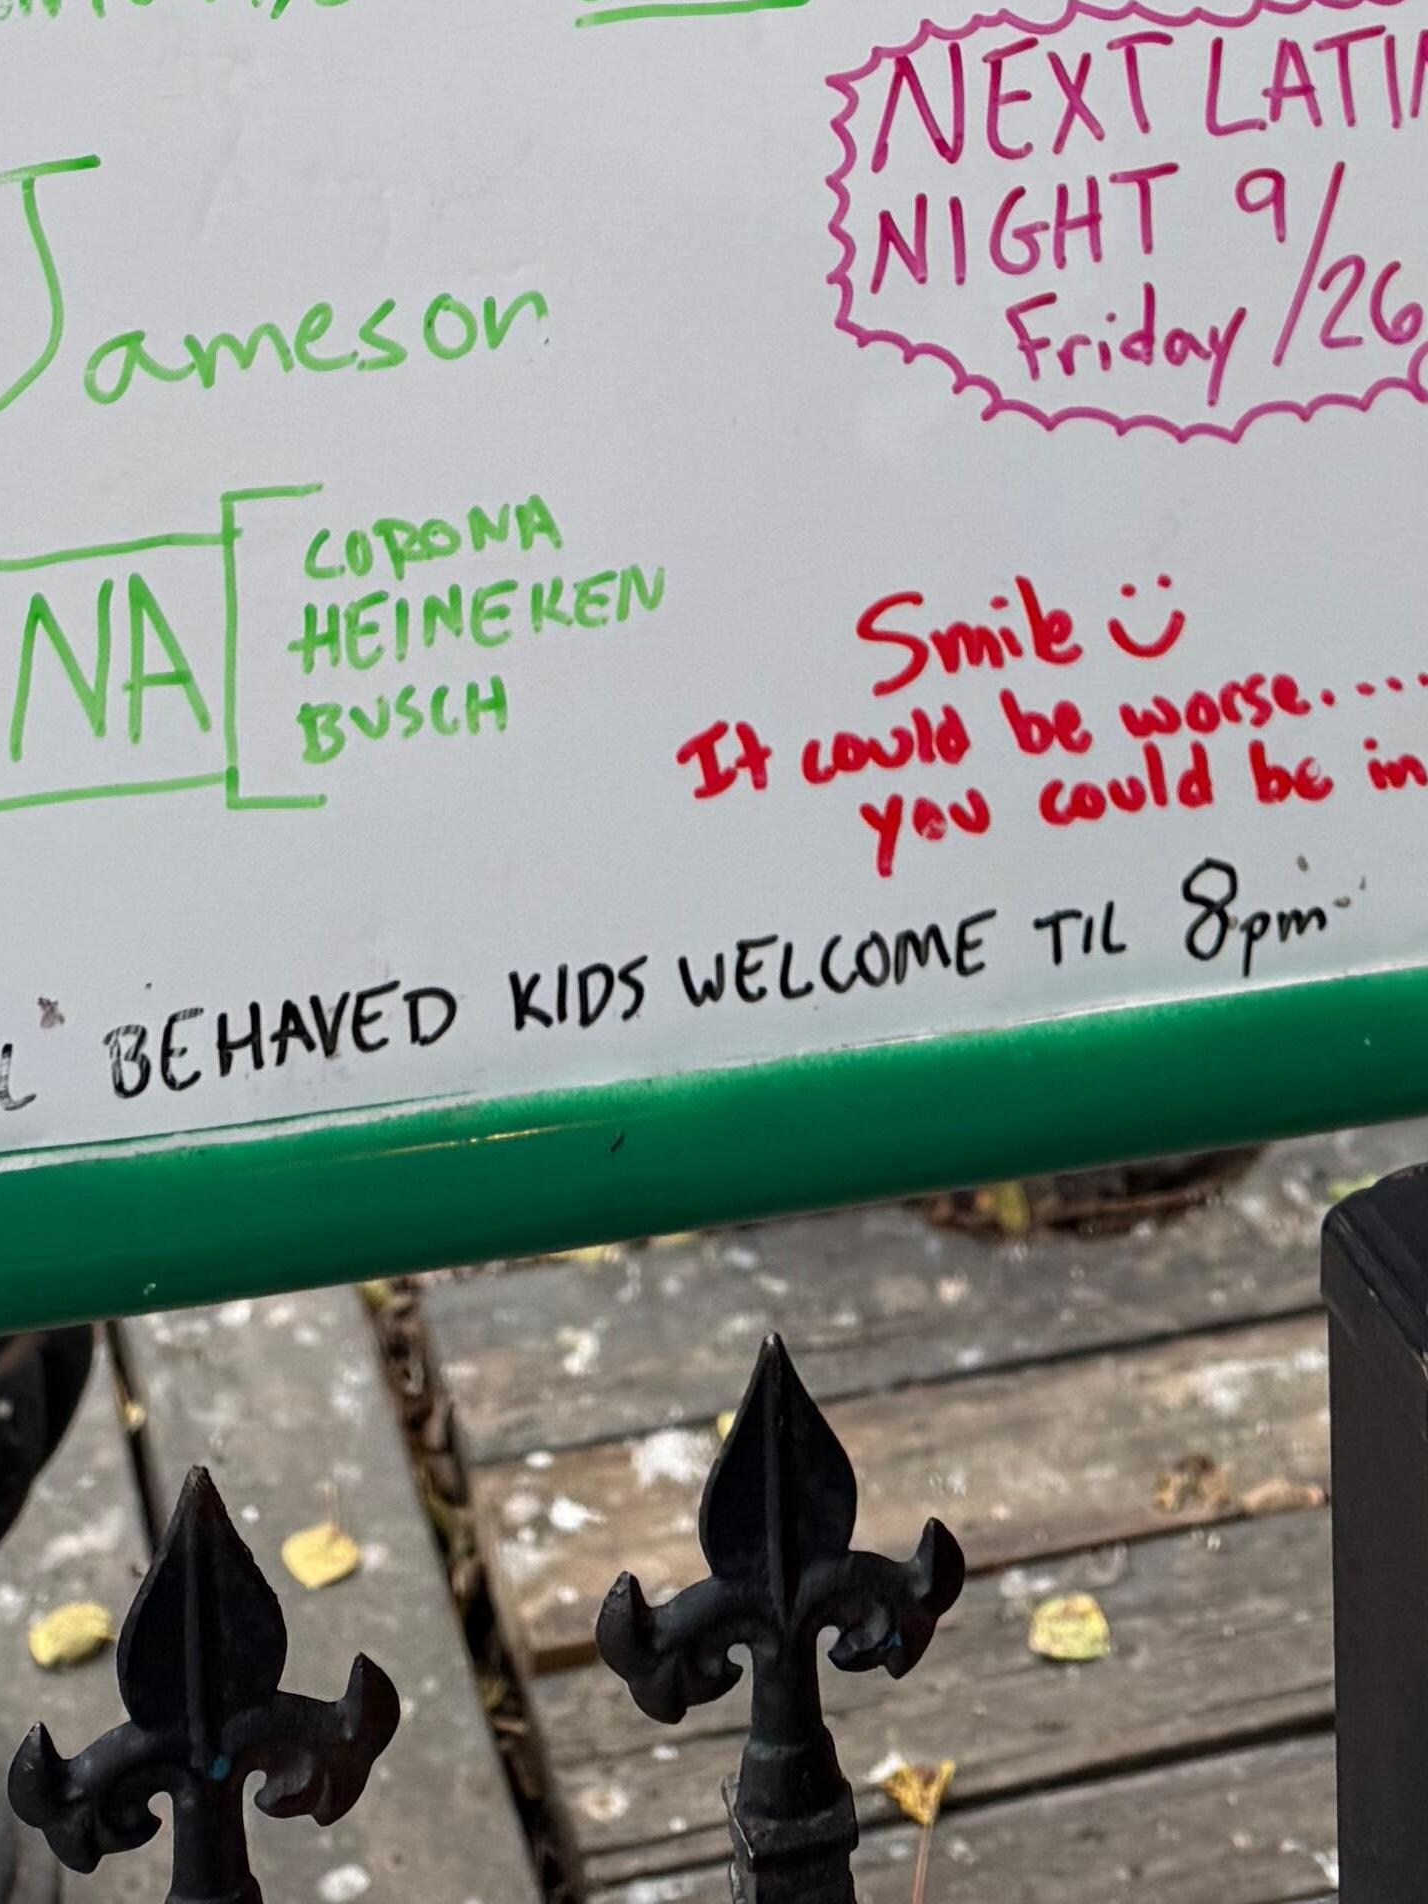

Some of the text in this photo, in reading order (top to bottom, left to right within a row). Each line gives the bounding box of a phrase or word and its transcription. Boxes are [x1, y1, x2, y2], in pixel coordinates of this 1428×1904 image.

[872, 34, 1173, 172] NEXT
[870, 162, 1422, 367] NIGHT 9/26
[1005, 282, 1247, 406] Friday
[303, 494, 562, 580] CORONA
[10, 574, 210, 763] NA
[287, 566, 666, 672] HEINEKEN
[855, 574, 1084, 698] Smile
[295, 675, 509, 766] BUSCH
[675, 720, 773, 801] It
[800, 704, 972, 785] could
[998, 687, 1094, 757] be
[858, 787, 992, 879] you
[1037, 740, 1214, 827] could
[1247, 739, 1335, 806] be
[103, 979, 458, 1100] BEHAVED
[507, 954, 649, 1033] KIDS
[677, 908, 998, 1009] WELCOME
[1032, 900, 1128, 967] TIL
[1180, 857, 1328, 978] 8pm
